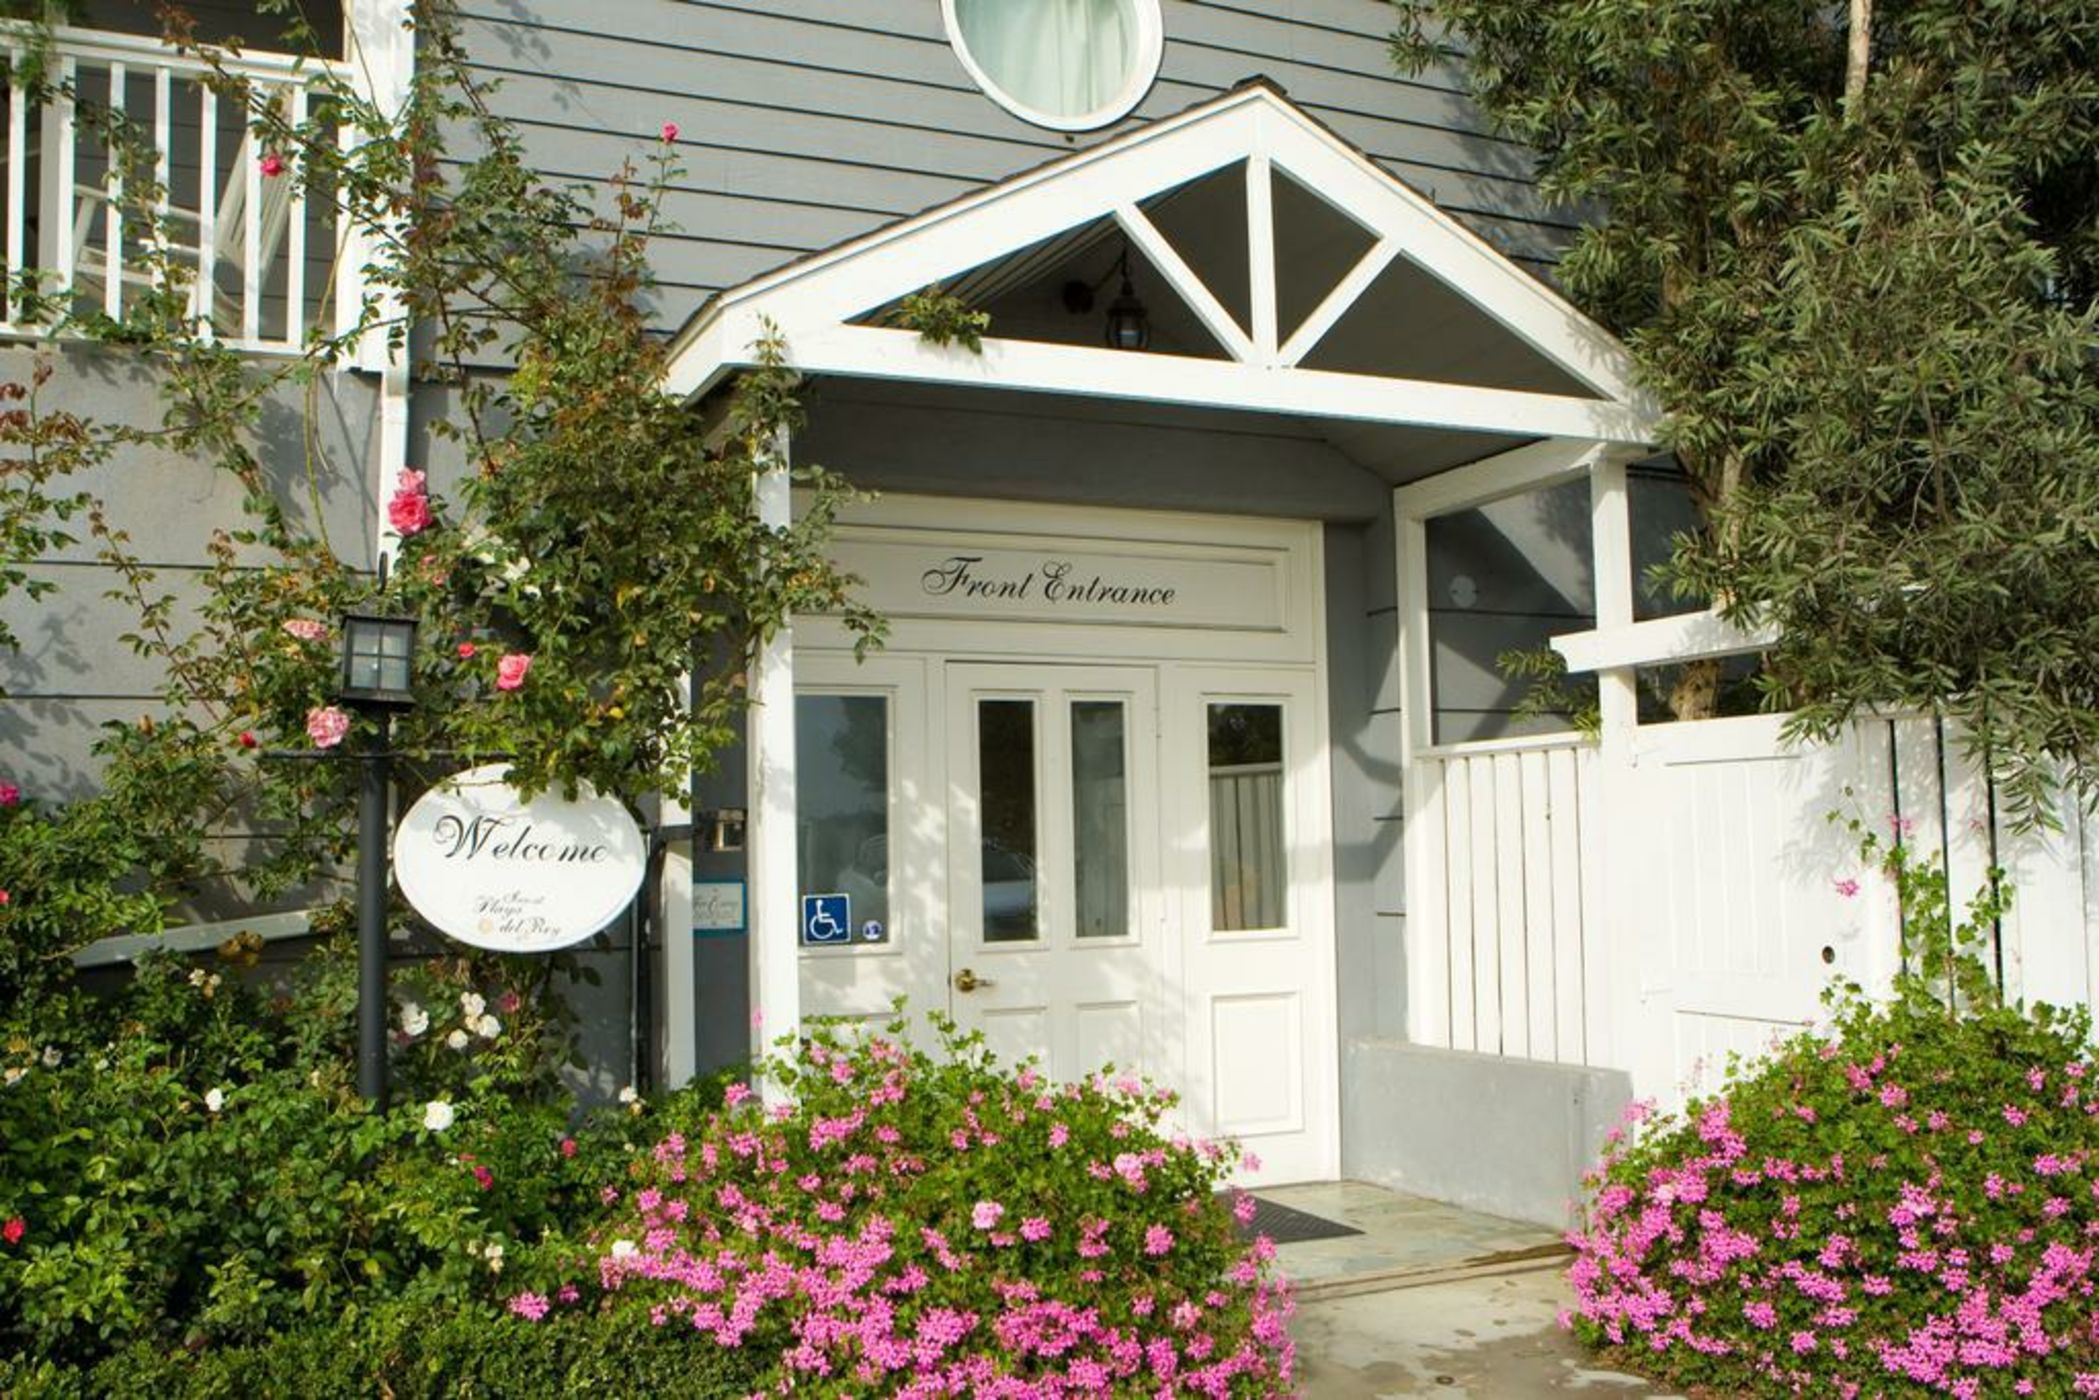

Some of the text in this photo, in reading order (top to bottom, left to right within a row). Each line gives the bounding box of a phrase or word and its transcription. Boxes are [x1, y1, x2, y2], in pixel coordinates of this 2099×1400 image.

[922, 556, 1175, 605] Front Entrance
[433, 815, 609, 863] Welcome
